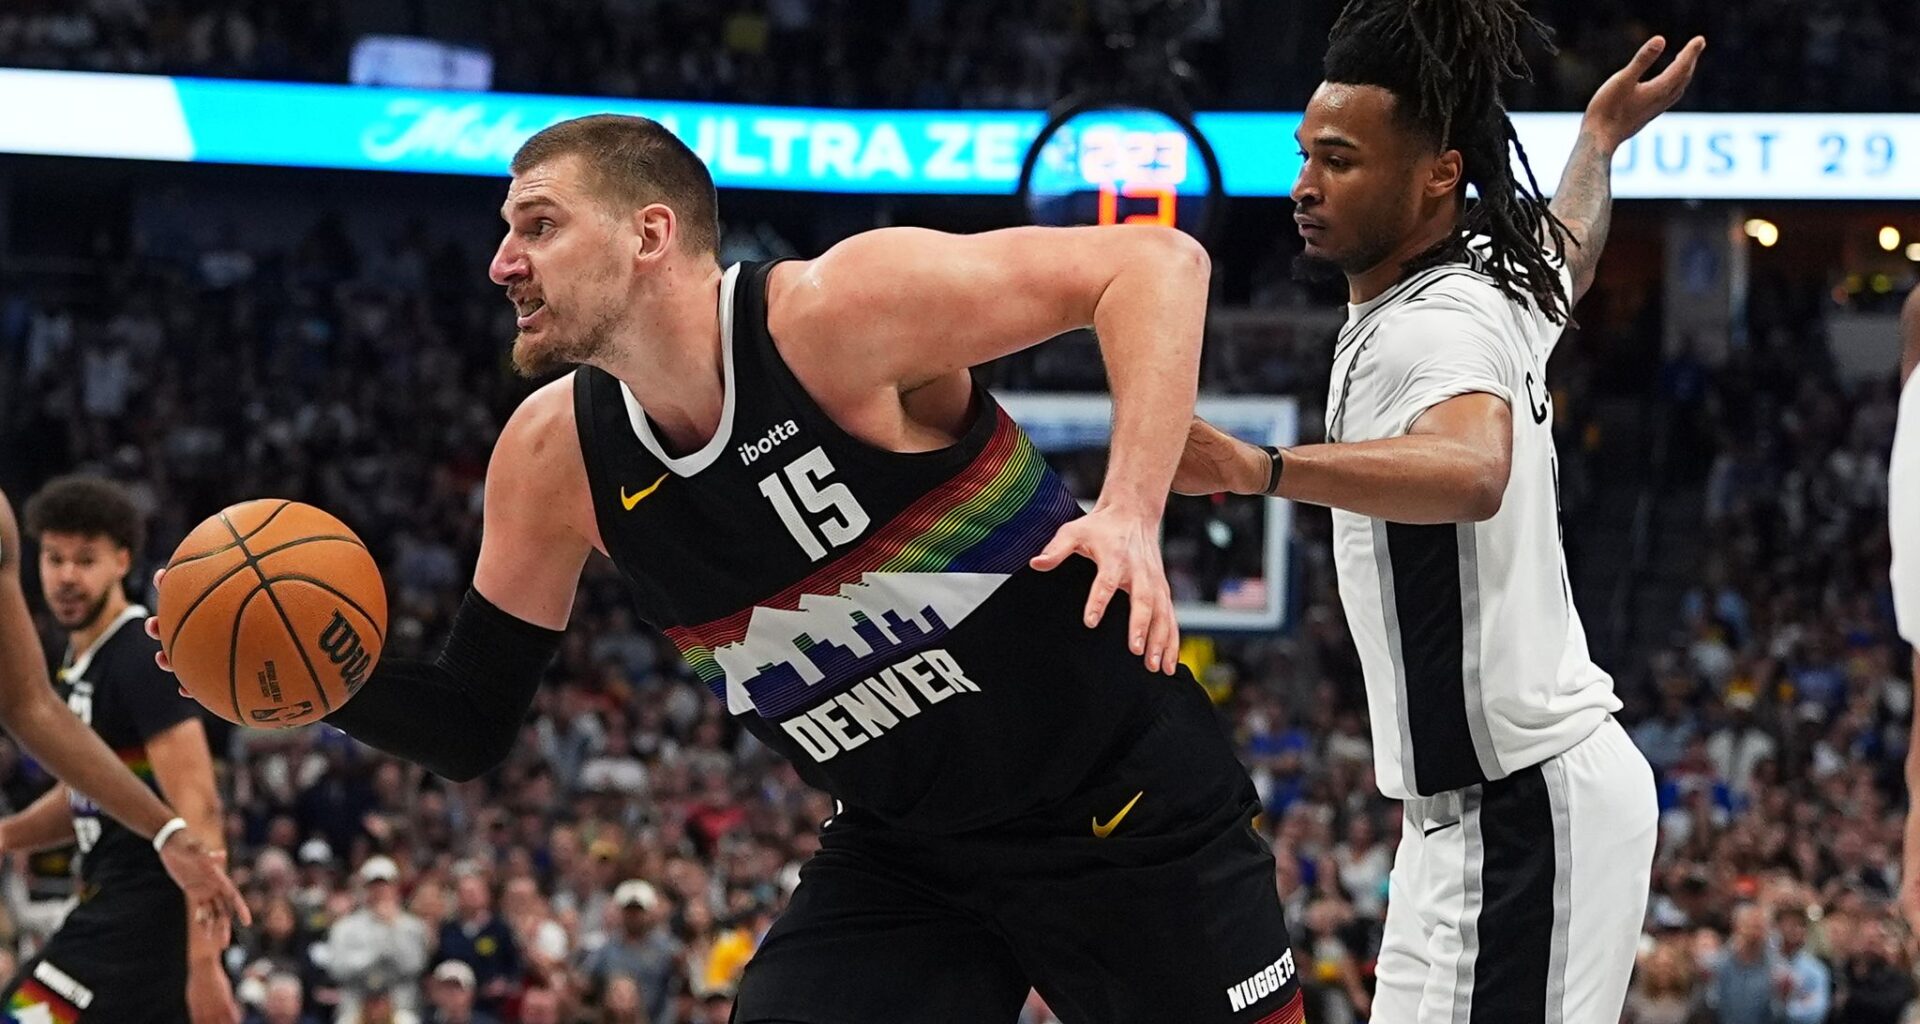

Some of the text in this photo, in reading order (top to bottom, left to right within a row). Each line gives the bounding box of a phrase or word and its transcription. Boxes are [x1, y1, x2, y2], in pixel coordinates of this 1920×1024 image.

[921, 121, 1045, 180] ZE
[1818, 131, 1896, 176] 29
[738, 419, 799, 466] ibotta
[758, 445, 871, 562] 15
[780, 649, 982, 763] DENVER
[1226, 947, 1296, 1013] NUGGETS
